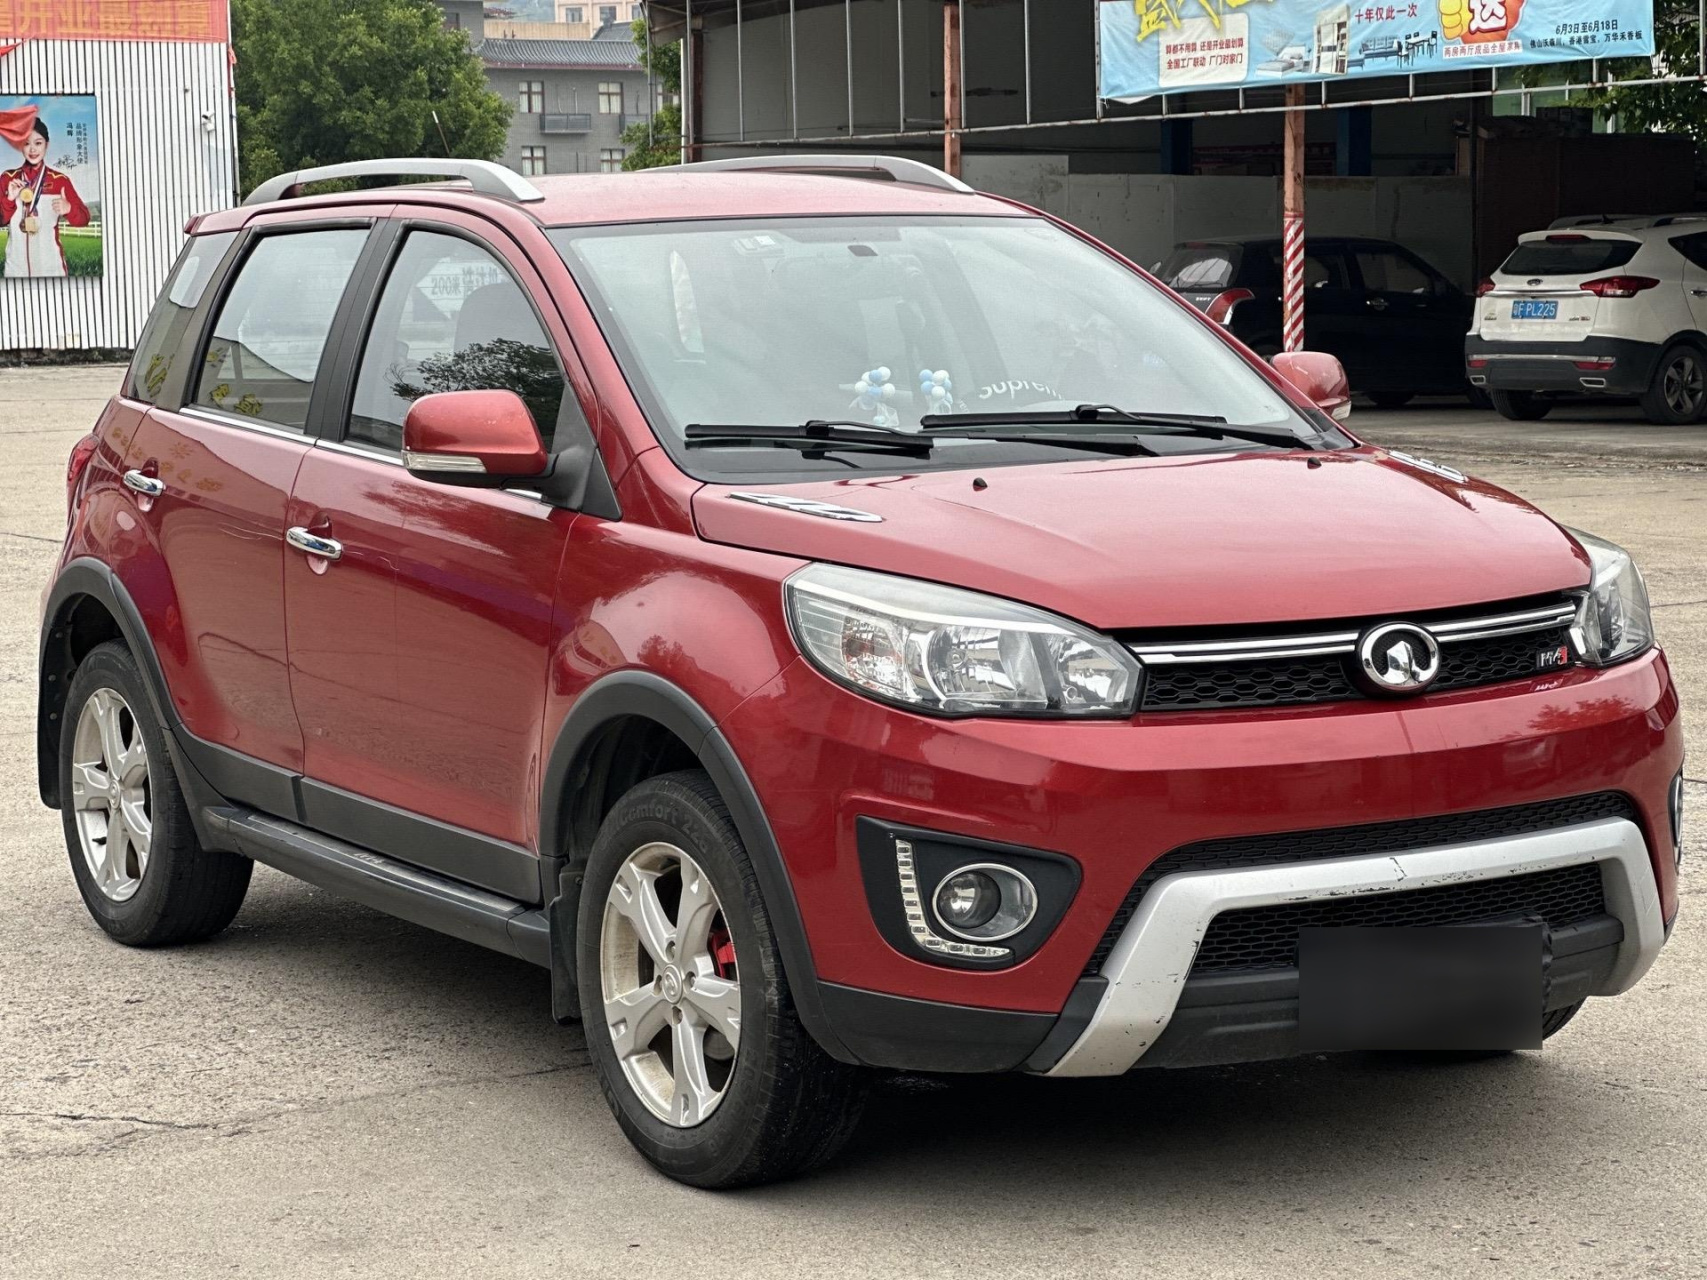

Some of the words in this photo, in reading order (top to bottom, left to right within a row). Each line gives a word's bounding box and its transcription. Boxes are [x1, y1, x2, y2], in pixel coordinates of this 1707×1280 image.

[1355, 2, 1418, 24] 十年仅此一次
[1556, 19, 1618, 35] 6月3日至6月18日
[1167, 55, 1206, 70] 全国工厂联动
[1526, 303, 1556, 316] PL225
